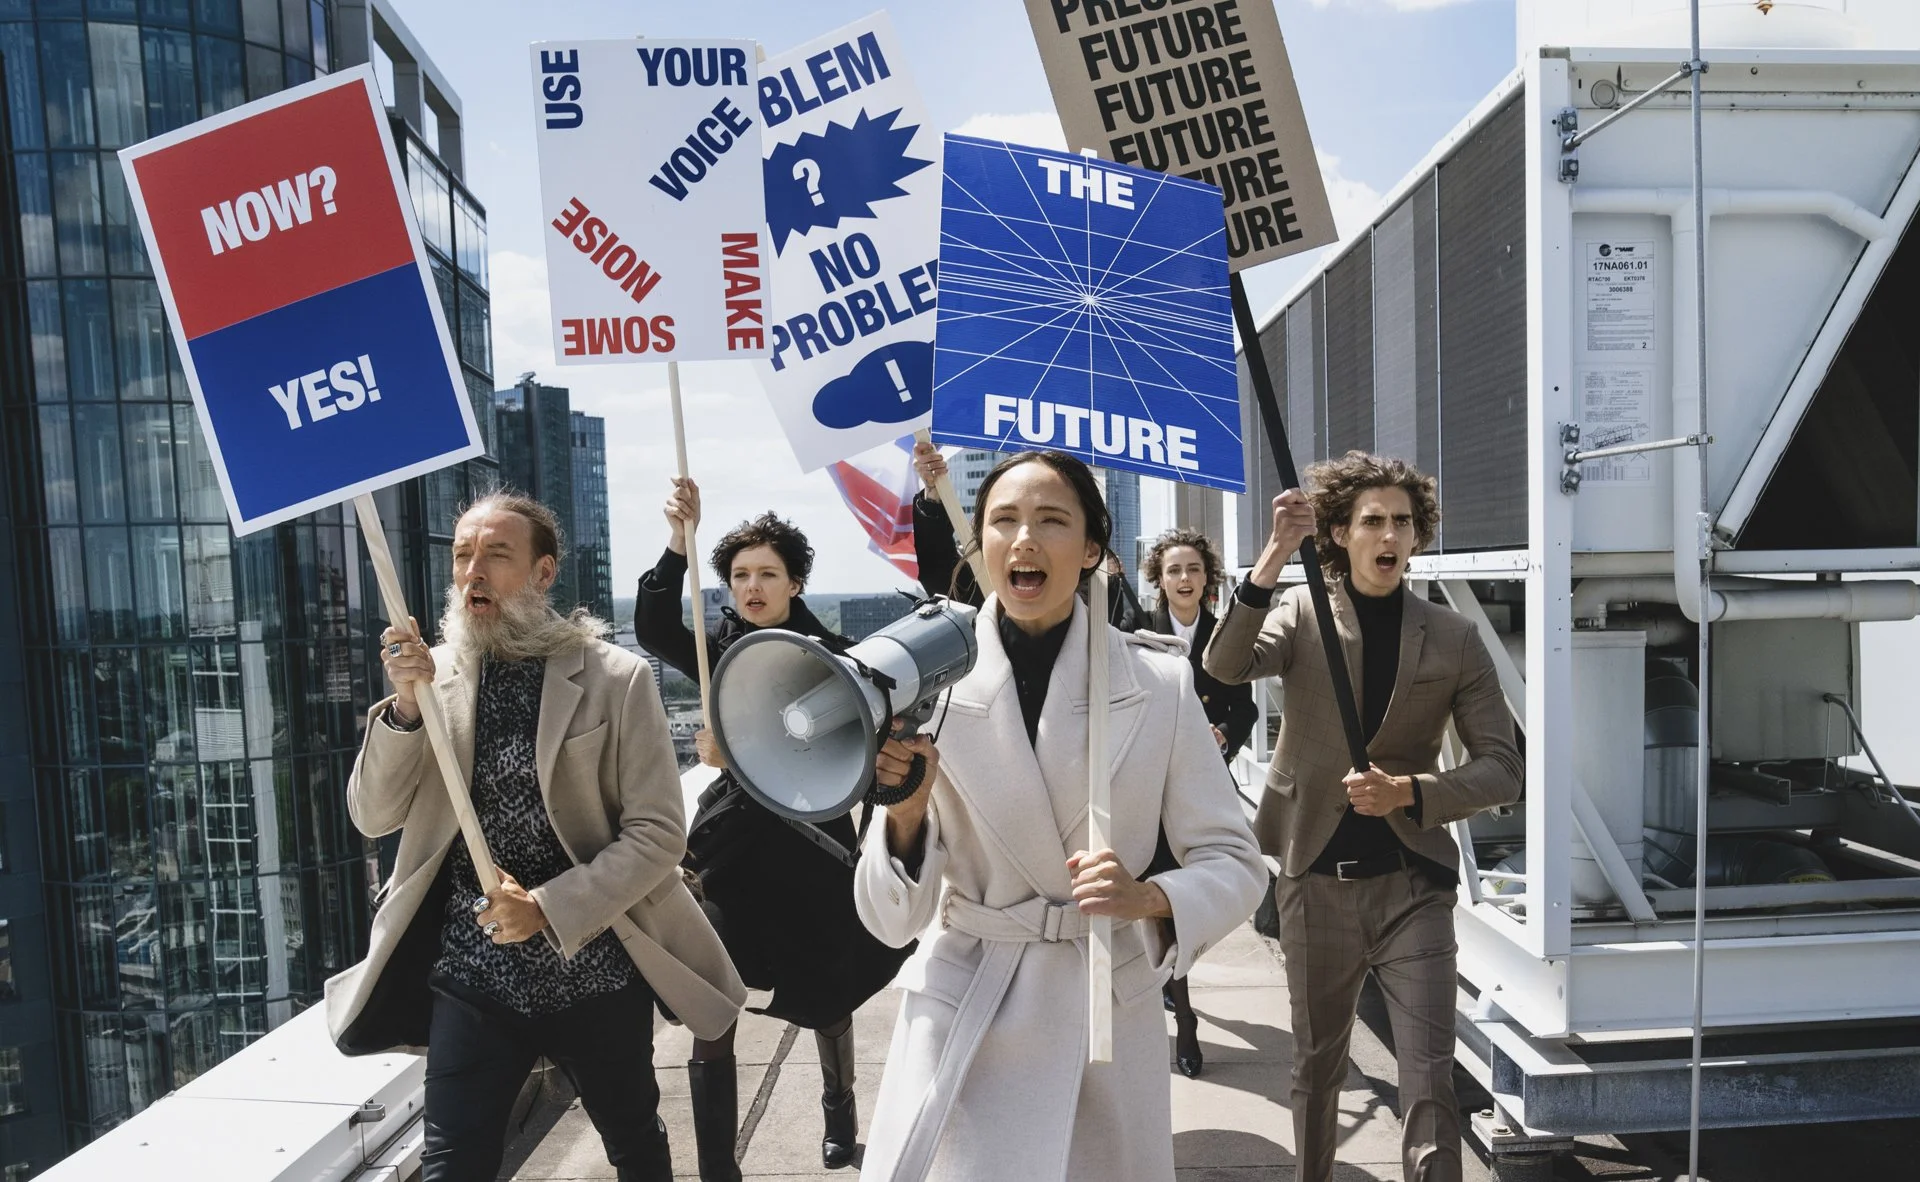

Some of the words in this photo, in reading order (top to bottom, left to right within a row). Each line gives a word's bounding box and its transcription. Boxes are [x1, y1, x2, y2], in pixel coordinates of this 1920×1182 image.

[636, 47, 749, 87] YOUR
[758, 31, 891, 128] BLEM
[1079, 1, 1248, 82] FUTURE
[540, 48, 584, 130] USE
[1093, 49, 1261, 132] FUTURE
[648, 96, 753, 202] VOICE
[1109, 98, 1276, 173] FUTURE
[200, 165, 338, 256] NOW?
[1038, 158, 1135, 211] THE
[551, 196, 662, 304] NOISE
[809, 232, 881, 294] NO
[1593, 260, 1648, 270] 17NA061.01
[721, 232, 765, 351] MAKE
[561, 315, 676, 356] SOME
[1642, 341, 1647, 349] 2
[268, 353, 382, 431] YES!
[983, 393, 1199, 471] FUTURE
